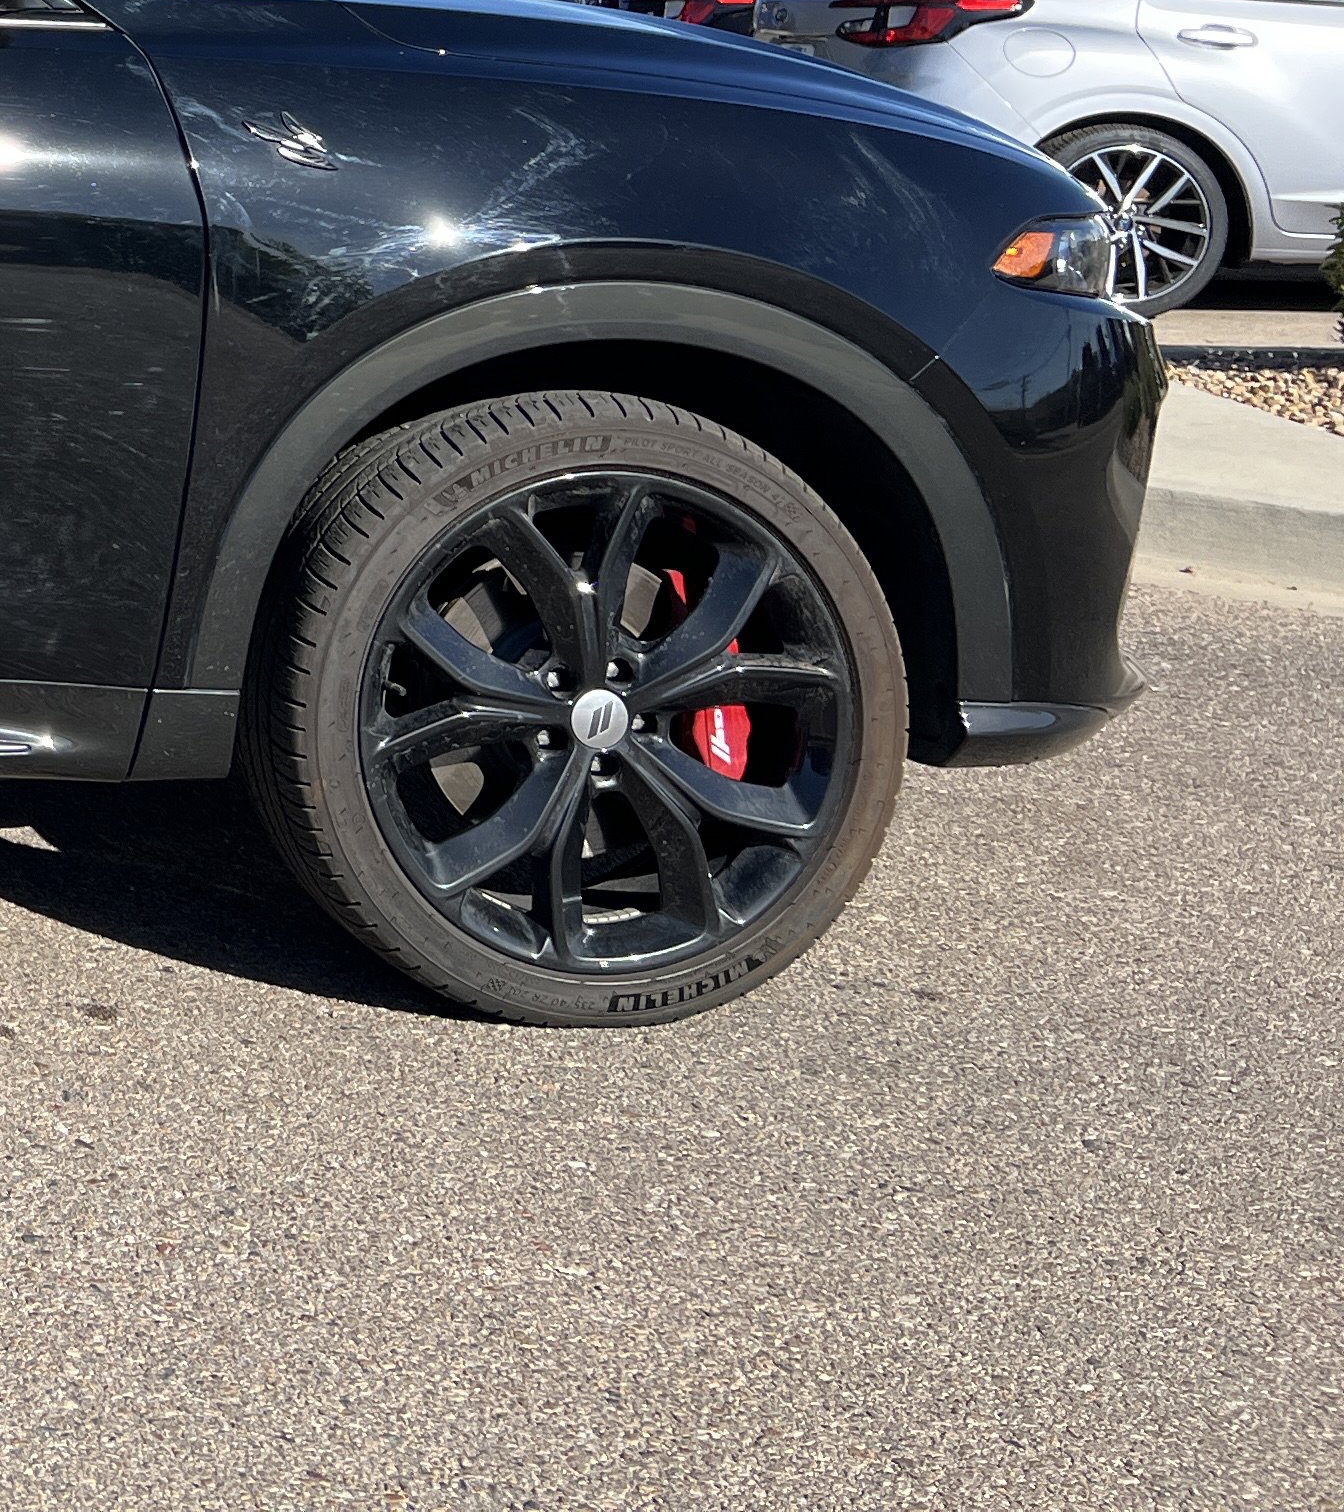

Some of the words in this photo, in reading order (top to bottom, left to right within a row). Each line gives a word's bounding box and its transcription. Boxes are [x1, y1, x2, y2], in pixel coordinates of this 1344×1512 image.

[470, 435, 605, 488] MICHELIN
[624, 439, 657, 448] PILOT
[661, 443, 698, 458] SPORT
[704, 454, 721, 469] ALL
[725, 463, 770, 493] SEASON
[616, 960, 750, 1012] MICHELIN
